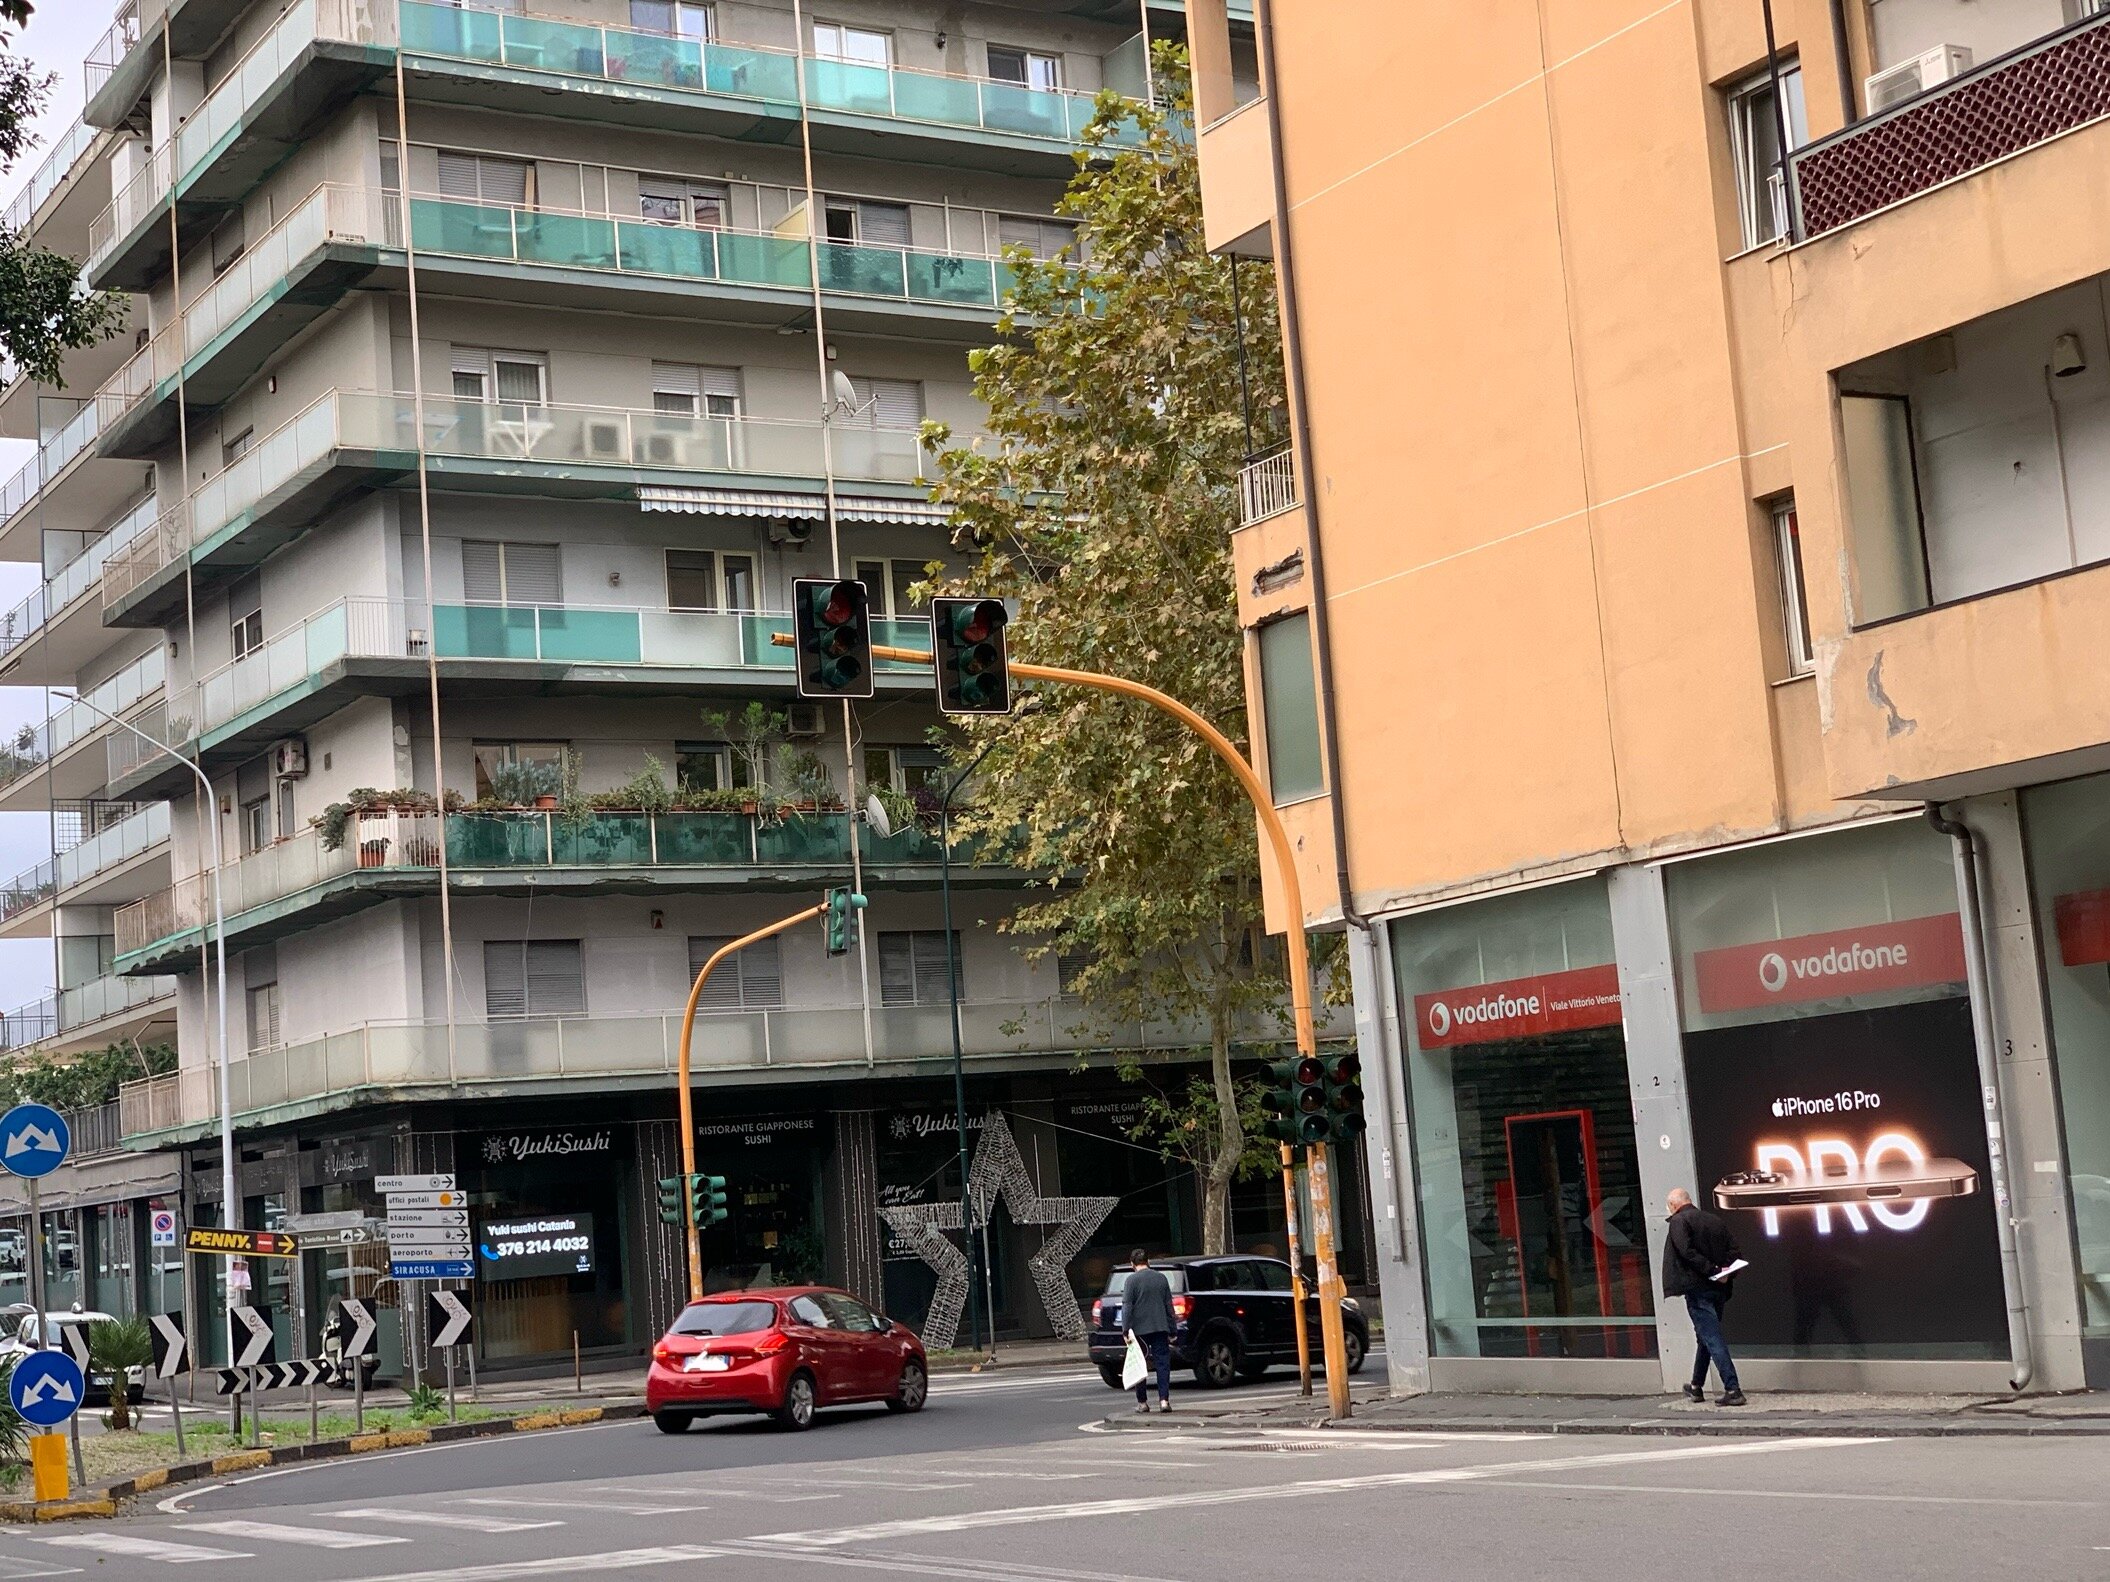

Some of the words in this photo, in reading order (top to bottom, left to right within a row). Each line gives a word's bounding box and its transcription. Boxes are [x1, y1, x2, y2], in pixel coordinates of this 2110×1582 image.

[1791, 943, 1908, 978] vodafone
[1453, 994, 1540, 1025] vodafone
[1550, 1001, 1568, 1011] Viale
[1568, 997, 1595, 1008] Vittorio
[1595, 994, 1621, 1005] Veneto
[2005, 1039, 2013, 1056] 3
[1653, 1076, 1660, 1086] 2
[1071, 1103, 1119, 1115] RISTORANTE
[1784, 1097, 1834, 1116] iPhone
[1835, 1091, 1853, 1111] 16
[1854, 1090, 1880, 1110] Pro
[1111, 1114, 1135, 1124] SUSHI
[698, 1123, 754, 1136] RISTORANTE
[756, 1120, 814, 1132] GIAPPONESE
[509, 1131, 611, 1160] YukiSushi
[744, 1135, 771, 1145] SUSHI
[389, 1196, 405, 1204] uffici
[407, 1195, 430, 1205] postali
[487, 1224, 510, 1236] Yuki
[511, 1222, 537, 1235] sushi
[538, 1220, 576, 1232] Catania
[392, 1249, 433, 1257] aeroporto
[497, 1241, 525, 1257] 376
[526, 1239, 551, 1254] 214
[553, 1236, 589, 1252] 4032
[394, 1265, 436, 1275] SIRACUSA
